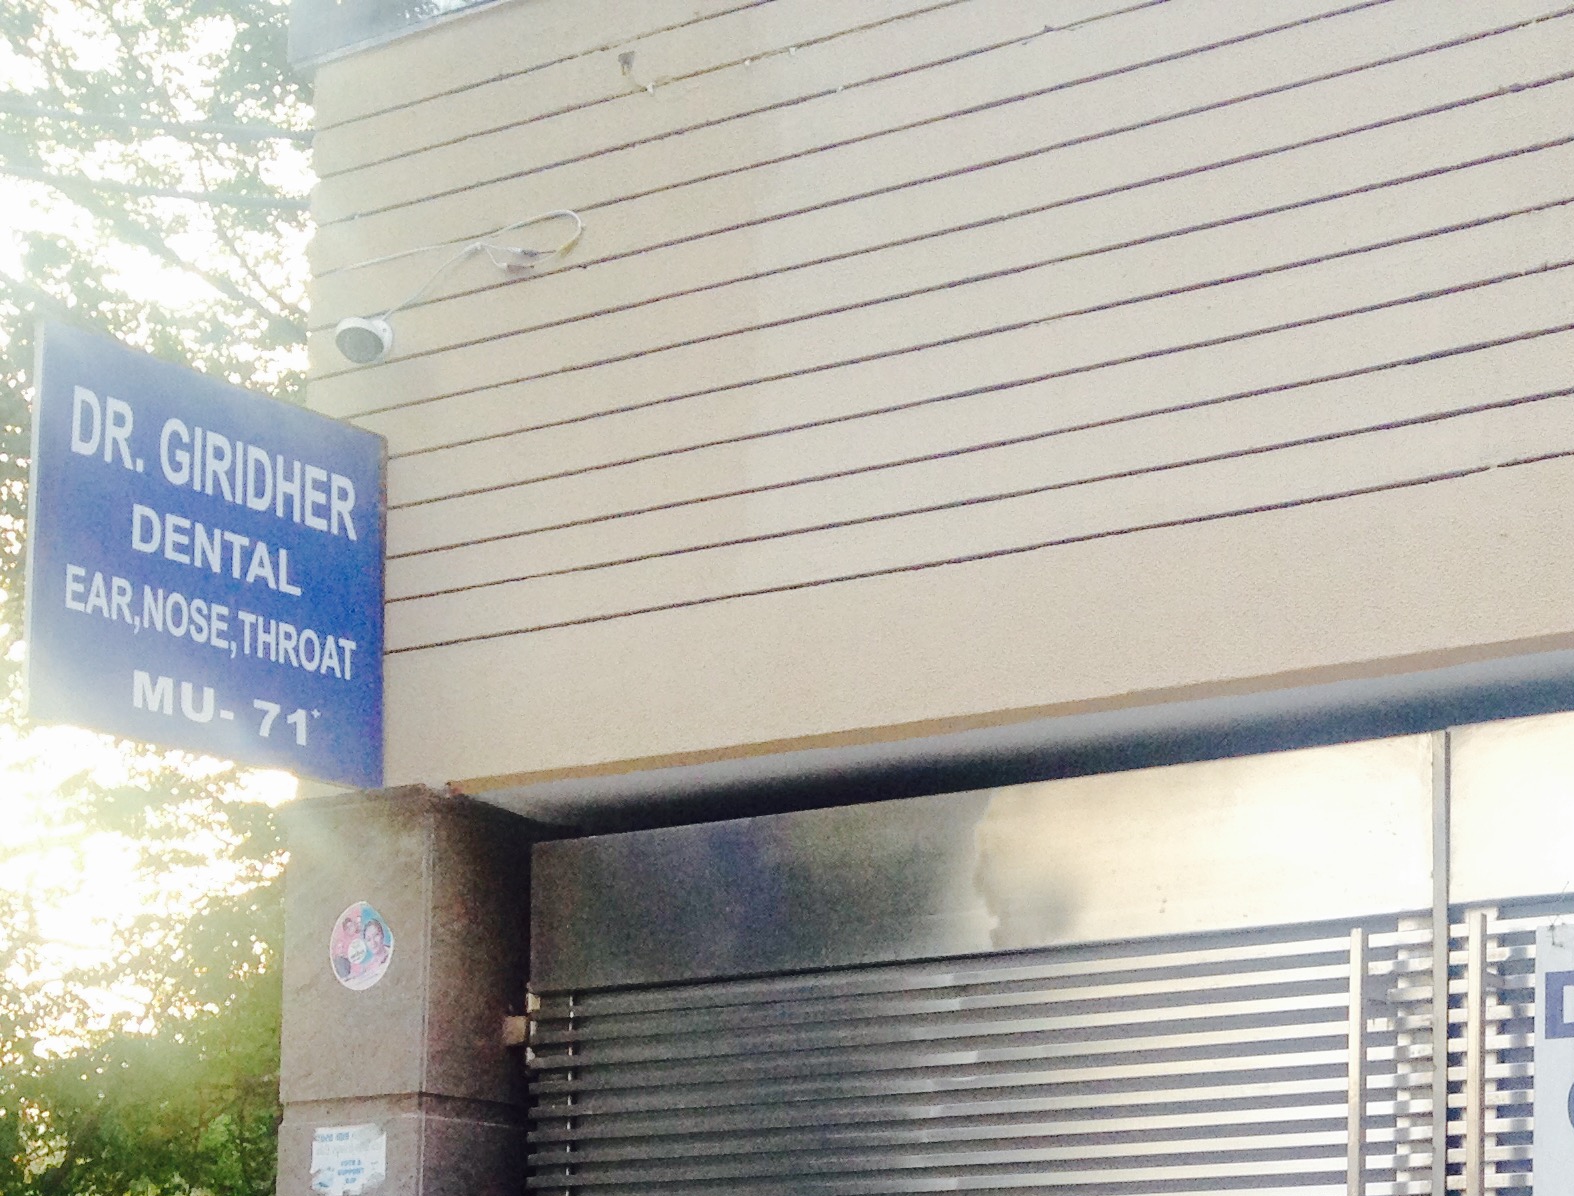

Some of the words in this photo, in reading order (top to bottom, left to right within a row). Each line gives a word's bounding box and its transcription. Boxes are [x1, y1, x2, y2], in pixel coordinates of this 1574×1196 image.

[71, 385, 144, 473] DR.
[160, 417, 357, 540] GIRIDHER
[132, 503, 303, 596] DENTAL
